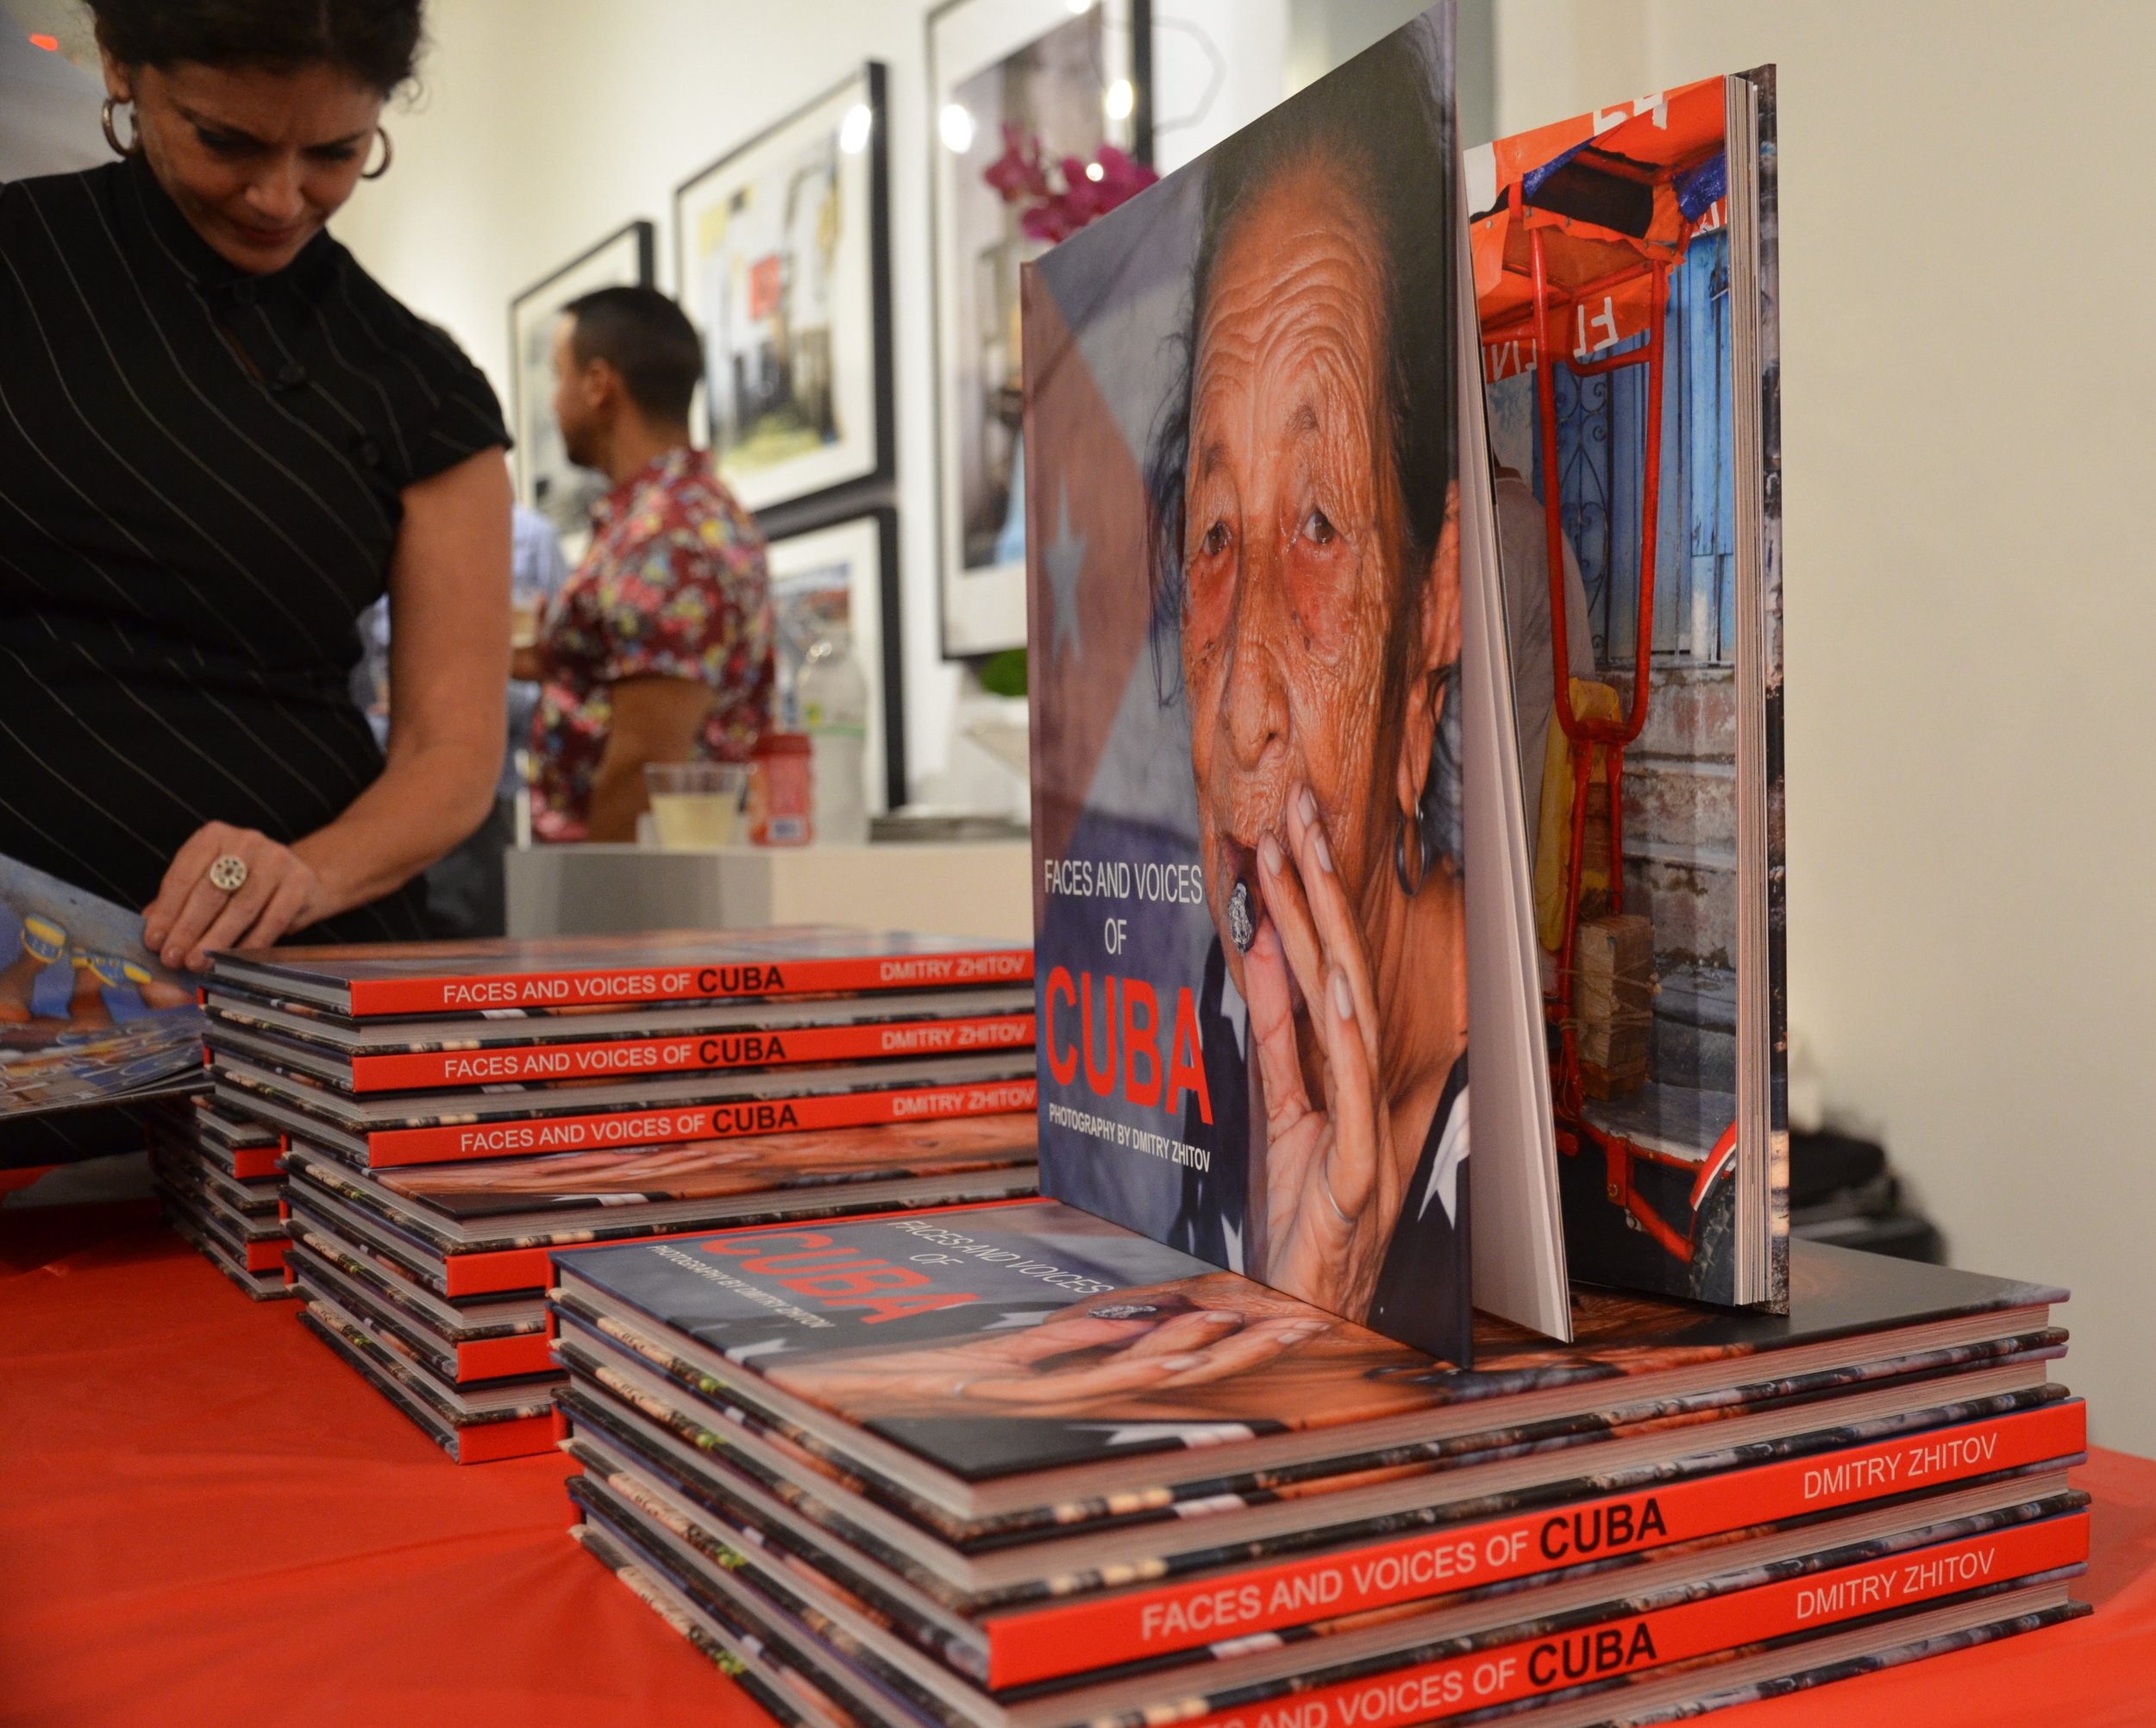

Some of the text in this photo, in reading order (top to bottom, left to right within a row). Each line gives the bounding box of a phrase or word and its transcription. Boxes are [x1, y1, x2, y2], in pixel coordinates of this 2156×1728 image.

[1044, 859, 1203, 905] FACES AND VOICES
[1105, 917, 1127, 955] OF
[443, 966, 785, 1004] FACES AND VOICES OF CUBA
[880, 955, 1026, 980] DMITRY ZHITOV
[444, 1036, 786, 1078] FACES AND VOICES OF CUBA
[881, 1023, 1027, 1050] DMITRY ZHITOV
[1045, 965, 1213, 1125] CUBA
[893, 1087, 1035, 1117] DMITRY ZHITOV
[461, 1105, 798, 1152] FACES AND VOICES OF CUBA
[1049, 1103, 1211, 1174] PHOTOGRAPHY BY DMITRY ZHITOV
[700, 1232, 981, 1324] CUBA
[887, 1220, 1114, 1293] FACES AND VOICES
[910, 1253, 964, 1265] OF
[1803, 1433, 1997, 1499] DMITRY ZHITOV
[1141, 1497, 1667, 1639] FACES AND VOICES OF CUBA
[1796, 1549, 1995, 1618] DMITRY ZHITOV
[1337, 1671, 1464, 1723] VOICES
[1472, 1659, 1518, 1696] OF
[1527, 1622, 1658, 1686] CUBA
